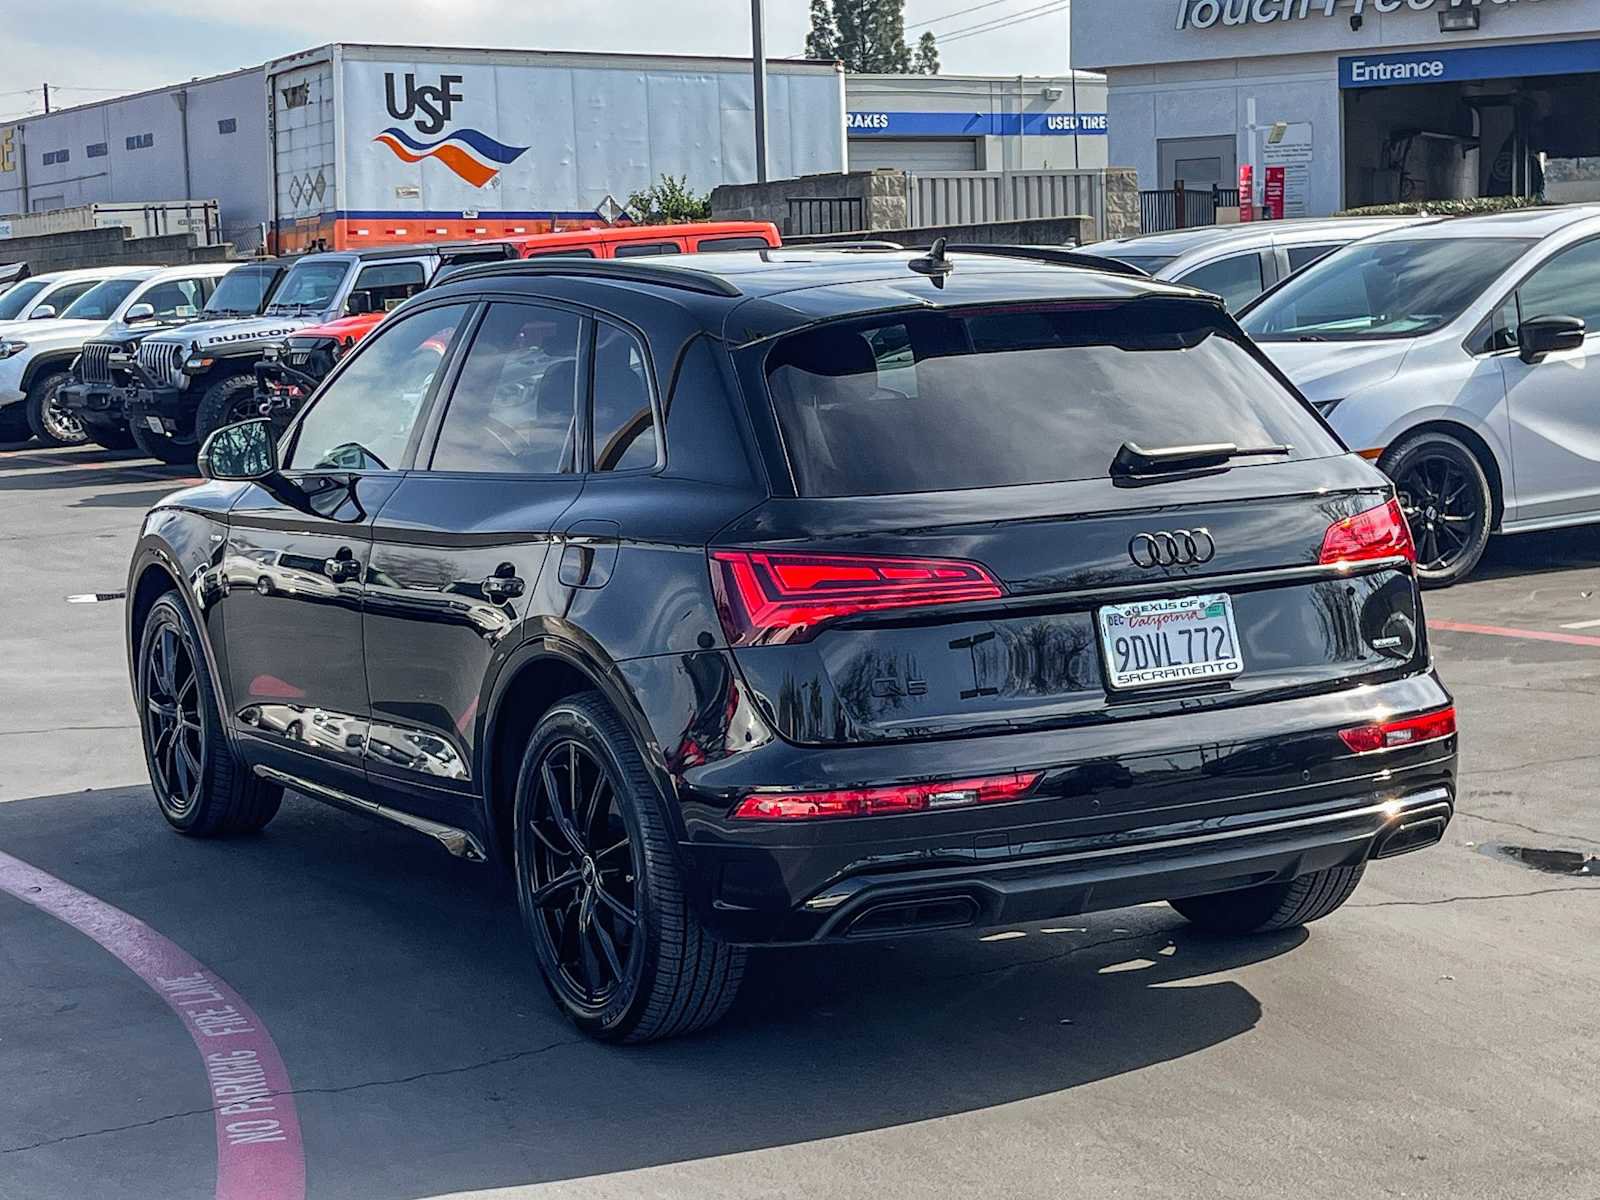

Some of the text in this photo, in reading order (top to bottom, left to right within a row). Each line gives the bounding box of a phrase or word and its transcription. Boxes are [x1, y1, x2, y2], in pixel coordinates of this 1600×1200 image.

[1351, 60, 1444, 82] Entrance
[384, 72, 464, 135] USF
[1047, 115, 1108, 130] USED TIRE
[208, 327, 297, 344] RUBICON
[1180, 600, 1198, 609] OF
[1129, 611, 1208, 630] California
[1115, 625, 1231, 673] 9DVL772
[1117, 661, 1239, 685] SACRAMENTO
[186, 1005, 255, 1037] FIRE
[207, 1050, 275, 1115] PARKING
[225, 1118, 286, 1145] NO
